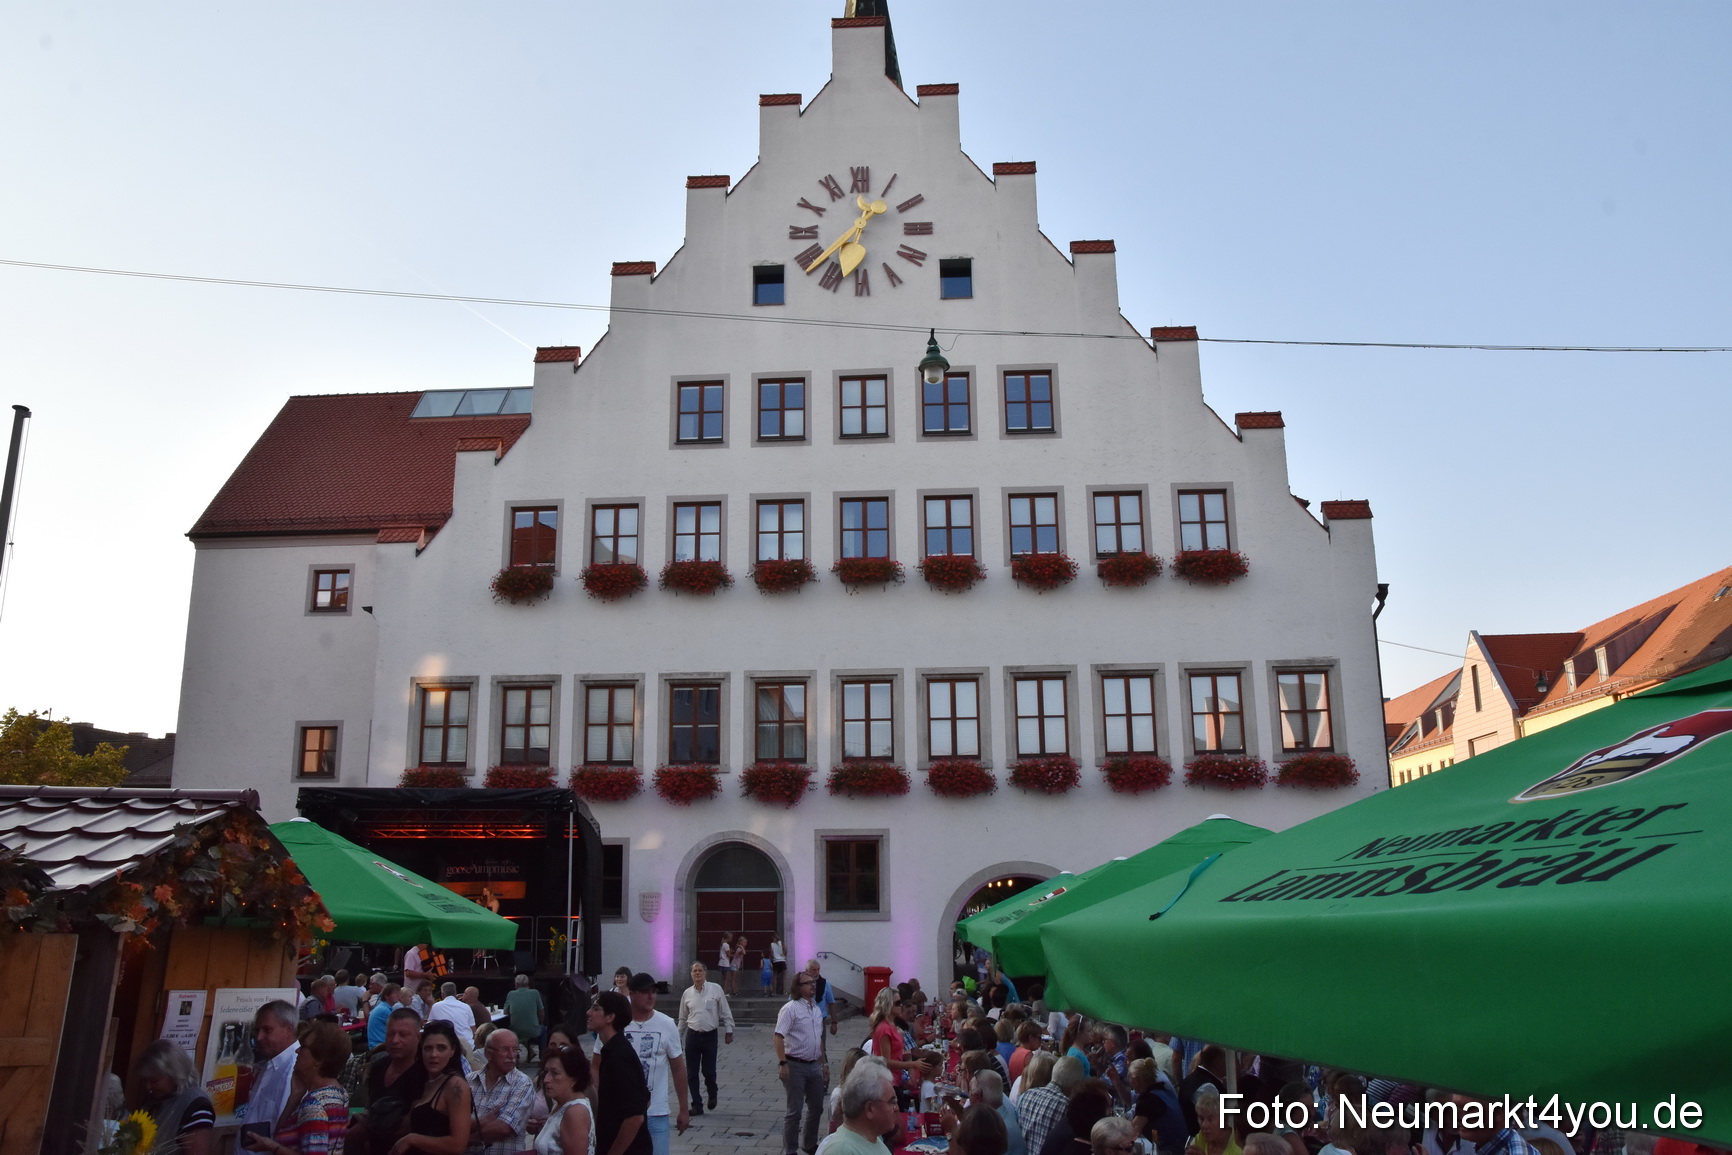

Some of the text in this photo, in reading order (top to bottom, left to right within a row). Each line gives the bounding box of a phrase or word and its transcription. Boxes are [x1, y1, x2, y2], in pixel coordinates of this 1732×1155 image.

[818, 174, 845, 202] XI
[850, 166, 869, 194] XII
[796, 197, 826, 217] X
[904, 221, 933, 235] III
[1334, 802, 1688, 861] Neumarkter
[1218, 838, 1678, 902] Lammsbräu
